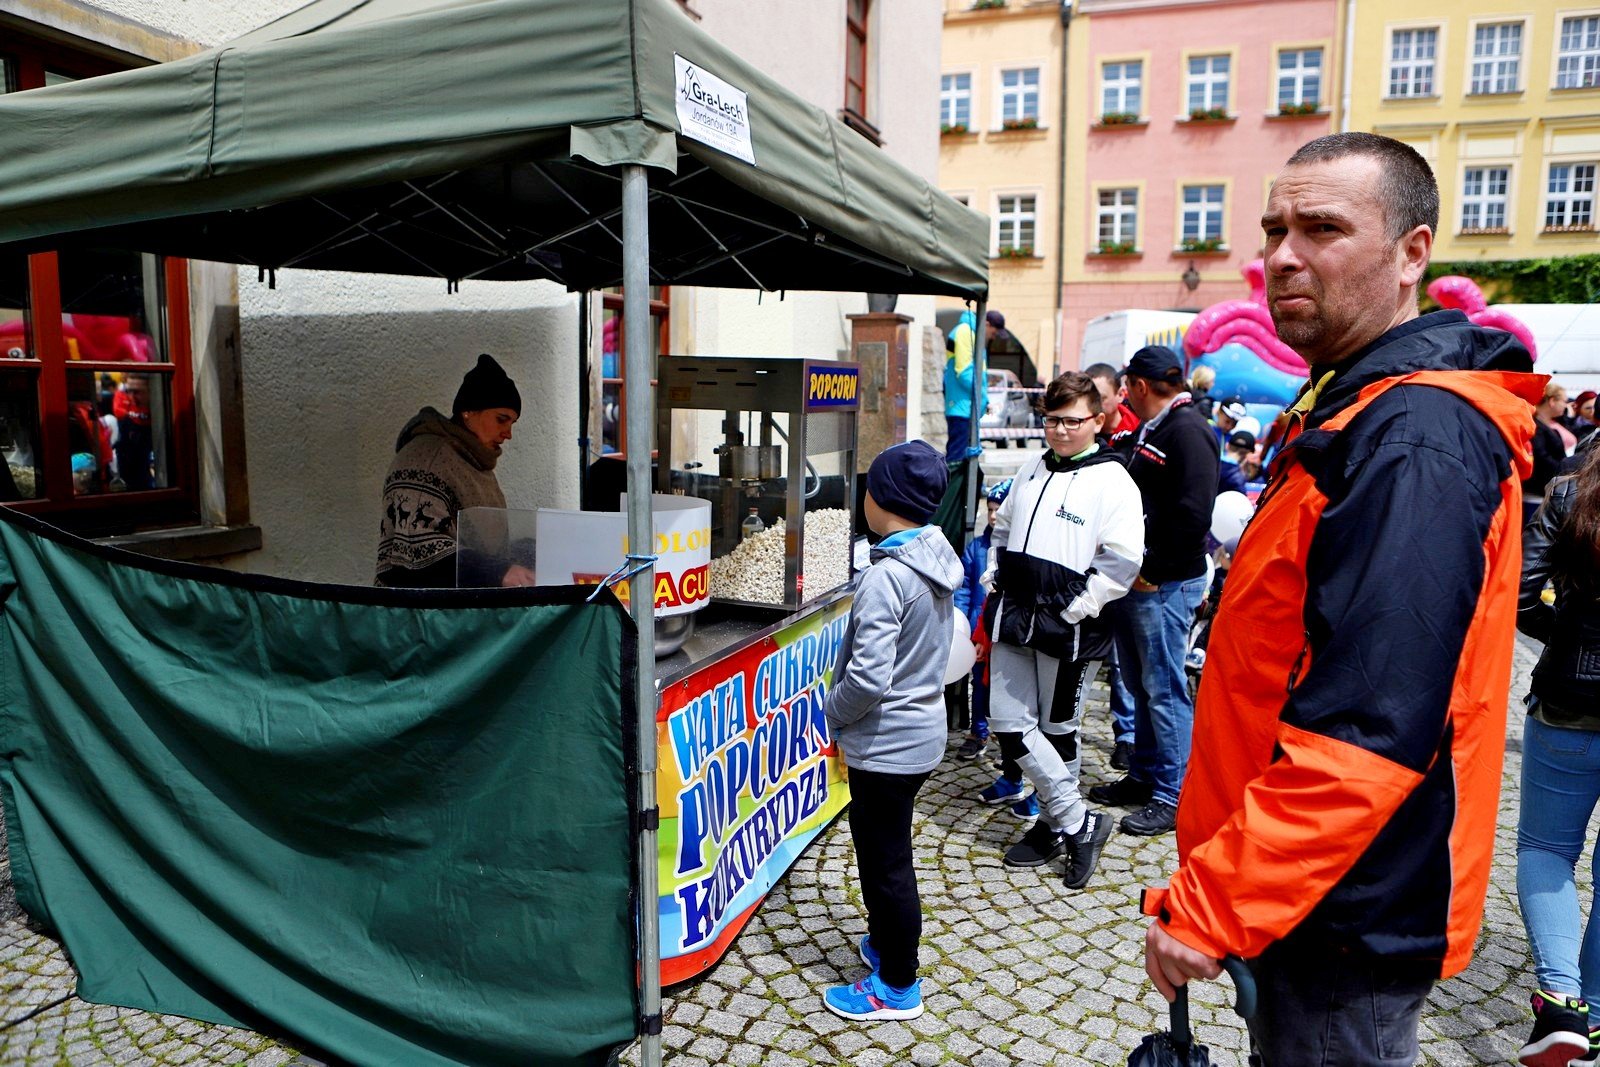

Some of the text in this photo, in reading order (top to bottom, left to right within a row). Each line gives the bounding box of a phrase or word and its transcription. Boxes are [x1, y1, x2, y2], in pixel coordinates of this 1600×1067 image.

[692, 82, 743, 121] Gra-Lech
[810, 373, 857, 400] POPCORN
[1055, 509, 1085, 526] DESIGN
[669, 673, 747, 782] WATA
[676, 683, 829, 875] POPCORN
[677, 757, 829, 949] KUKURYDZA
